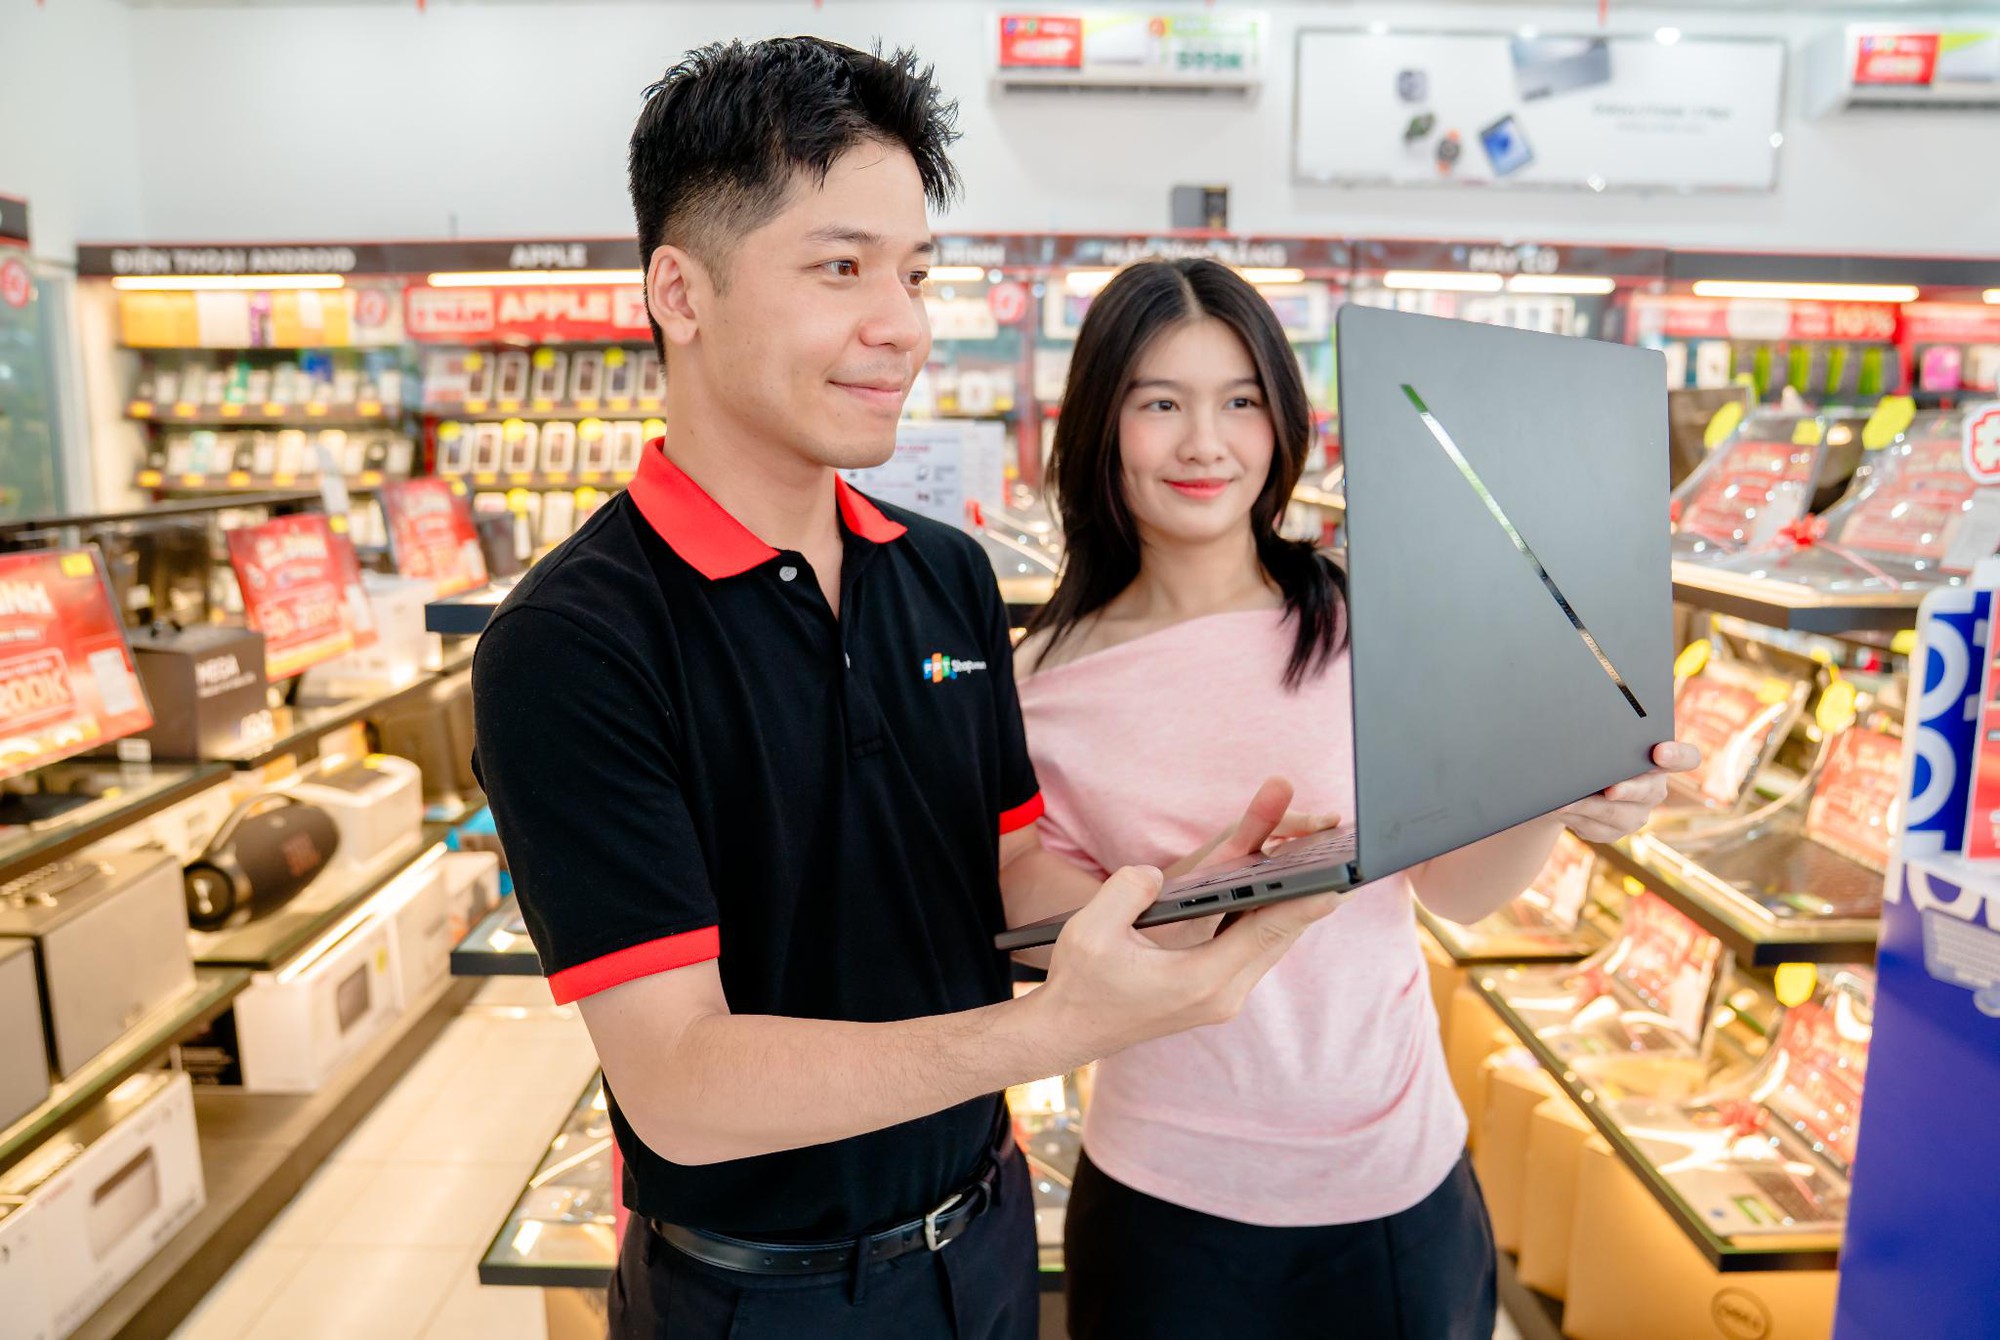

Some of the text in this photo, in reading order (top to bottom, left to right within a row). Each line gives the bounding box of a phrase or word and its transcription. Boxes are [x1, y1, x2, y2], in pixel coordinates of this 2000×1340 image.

[250, 247, 356, 273] ANDROID
[509, 244, 588, 269] APPLE
[499, 291, 610, 323] APPLE
